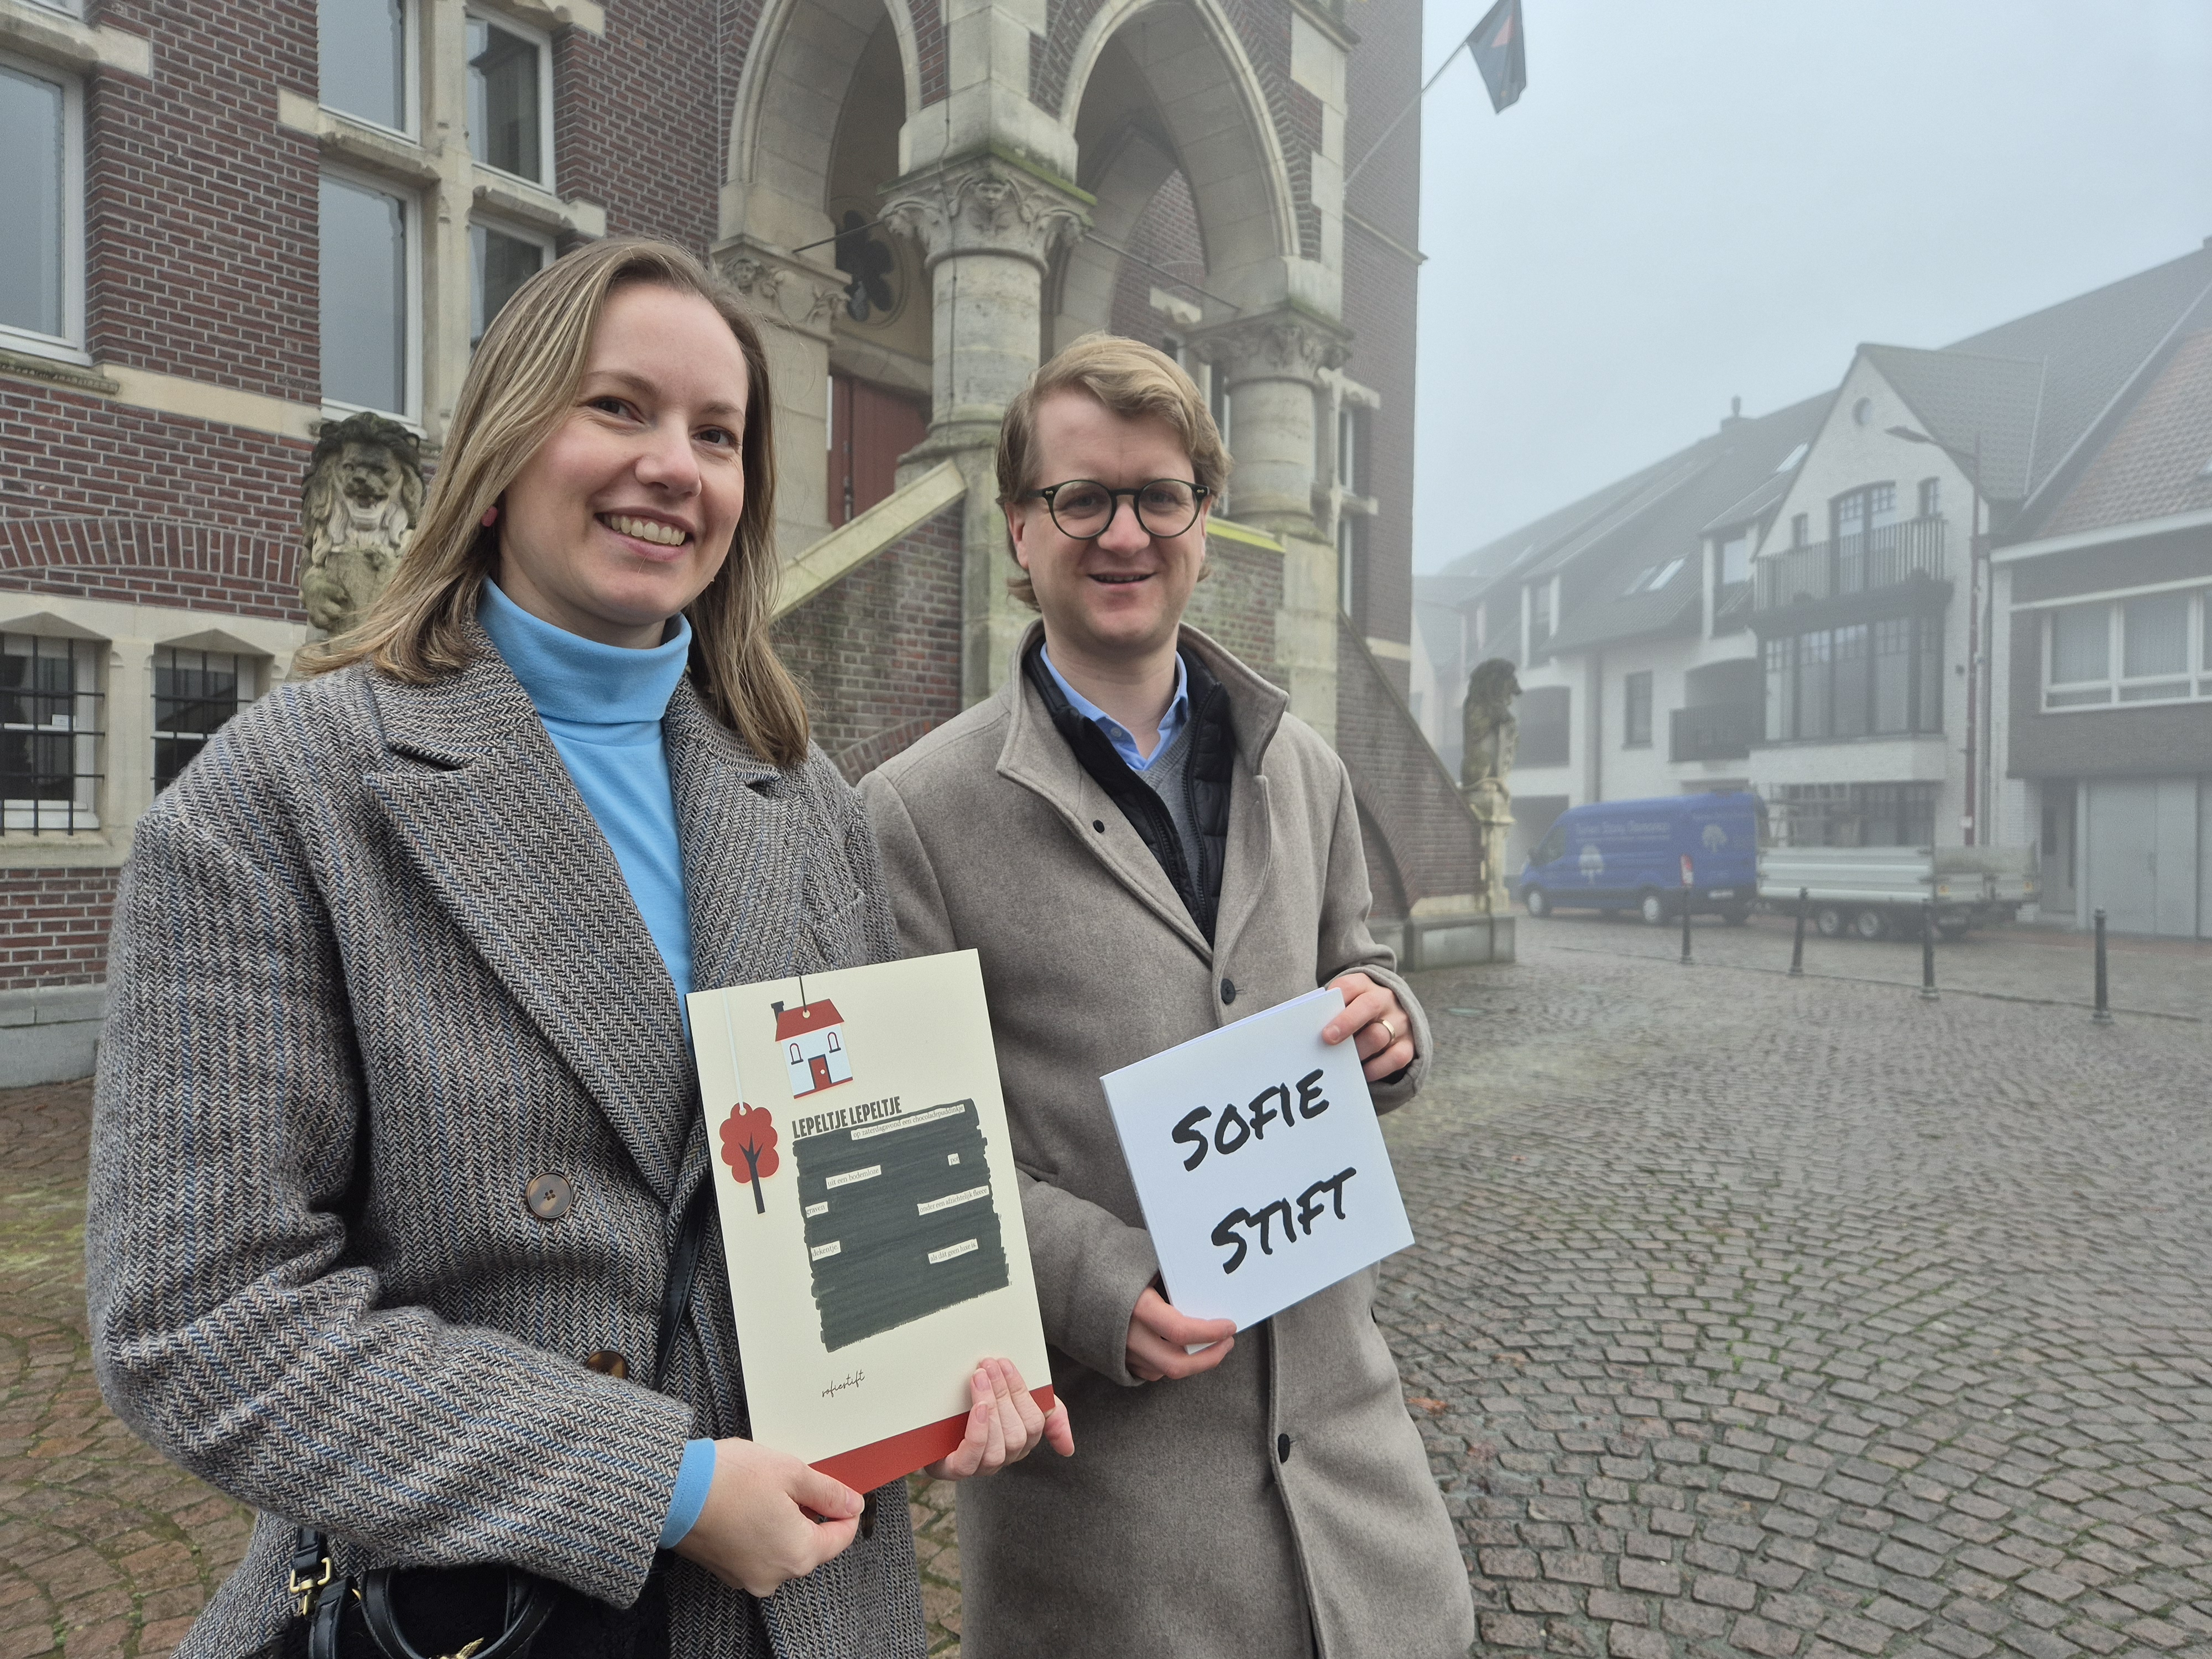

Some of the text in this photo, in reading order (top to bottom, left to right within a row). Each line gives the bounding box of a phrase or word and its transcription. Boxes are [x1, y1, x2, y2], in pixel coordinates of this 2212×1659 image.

[792, 1096, 902, 1139] LEPELTJE LEPELTJE
[853, 1131, 861, 1140] op
[862, 1120, 901, 1135] zaterdagavond
[912, 1104, 964, 1123] chocoladepuddinkje
[1171, 1068, 1329, 1172] SOFIE
[950, 1155, 959, 1165] pot
[848, 1168, 879, 1181] bodemloze
[920, 1203, 935, 1213] onder
[946, 1191, 973, 1205] afzichtelijk
[973, 1188, 987, 1197] fleece
[1211, 1167, 1357, 1274] STIFT
[812, 1244, 839, 1257] dekentje.
[938, 1250, 947, 1259] dát
[947, 1248, 960, 1258] geen
[821, 1369, 865, 1398] sofiestift
